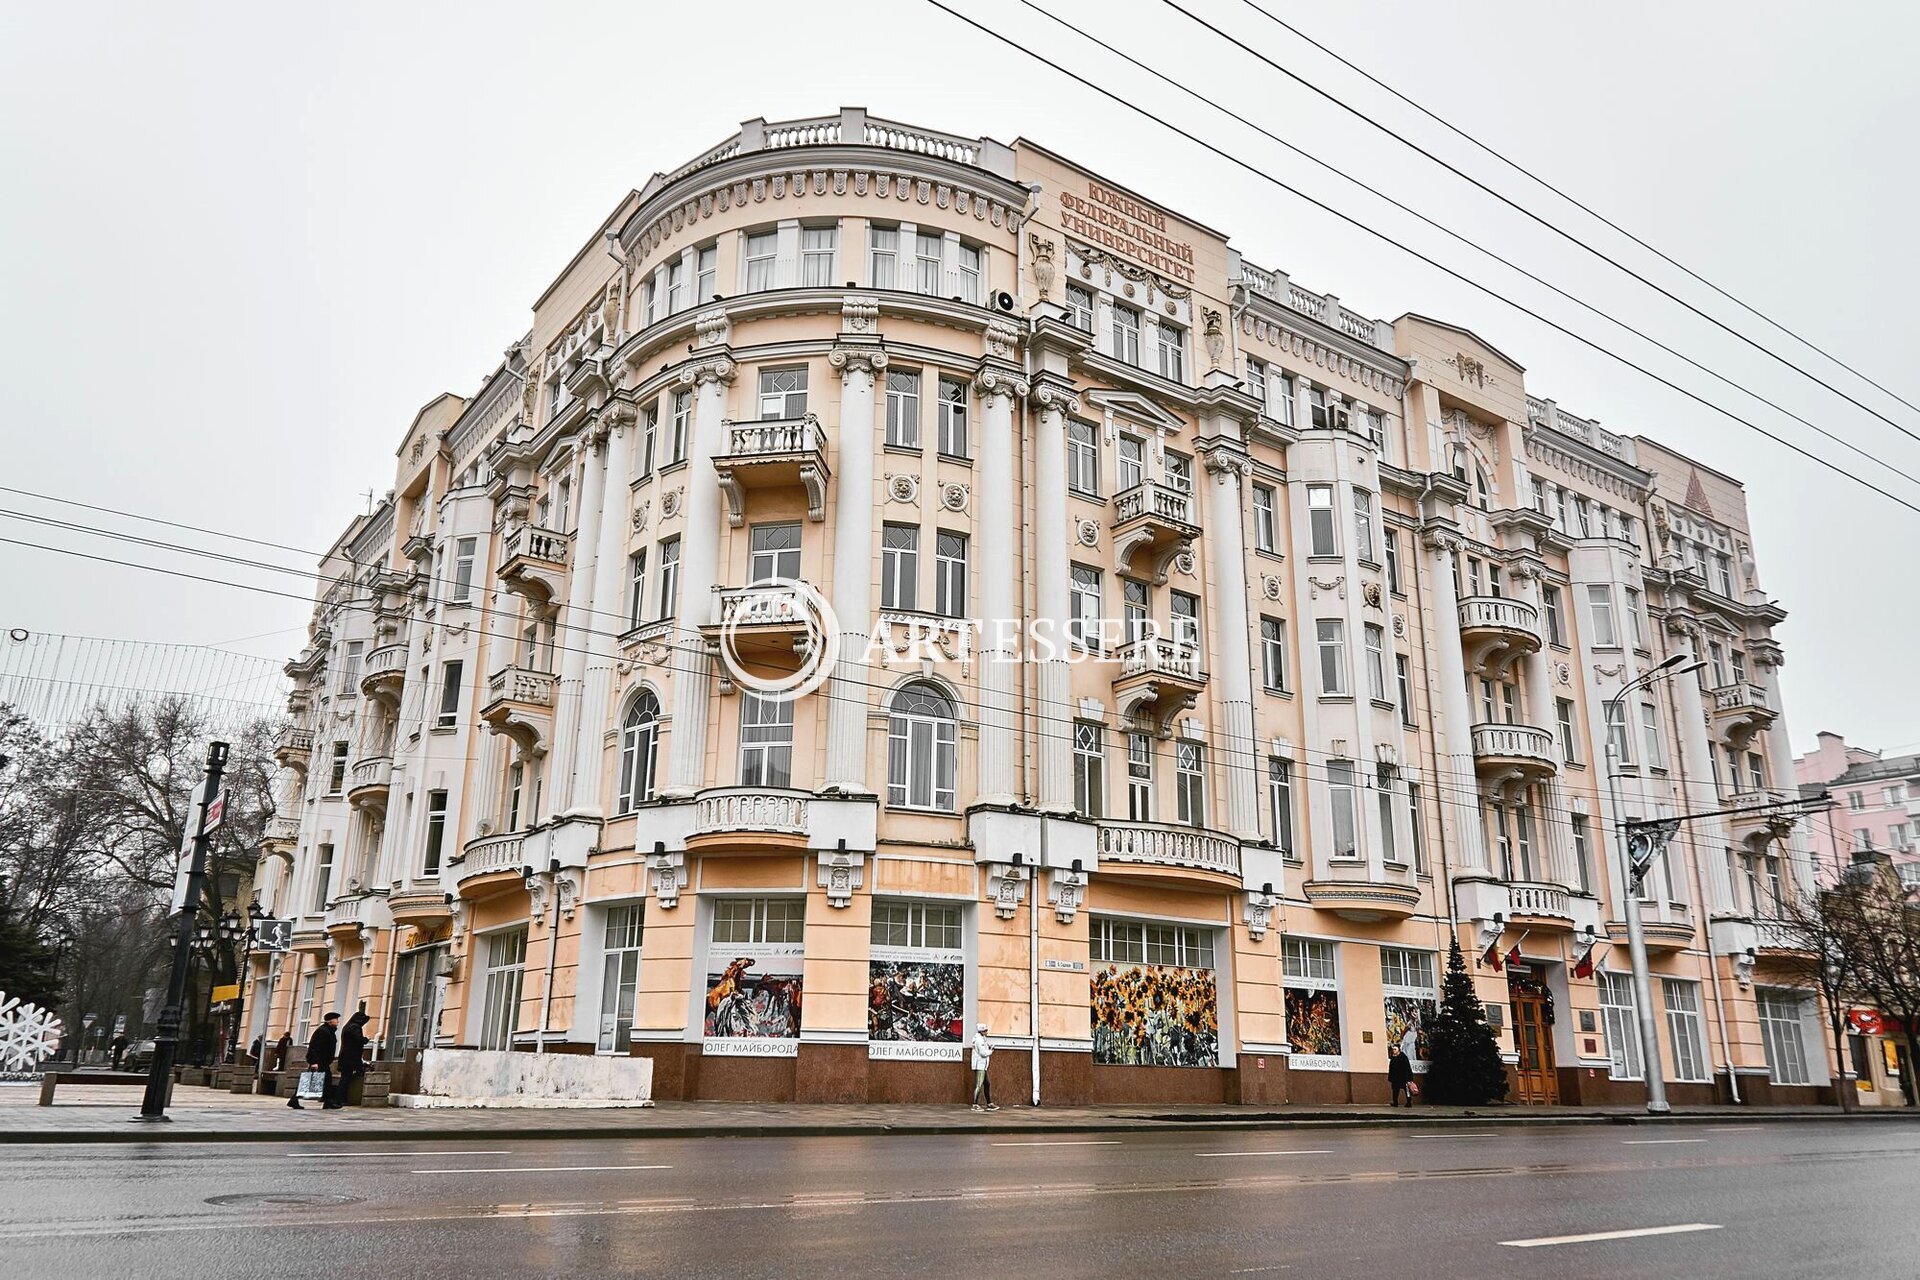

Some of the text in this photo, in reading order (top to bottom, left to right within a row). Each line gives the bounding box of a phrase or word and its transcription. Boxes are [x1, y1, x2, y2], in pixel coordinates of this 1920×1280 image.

[1088, 181, 1167, 233] ЮЖНЫЙ
[1060, 191, 1194, 265] ФЕДЕРАЛЬНЫЙ
[1060, 210, 1195, 284] УНИВЕРСИТЕТ
[704, 1042, 798, 1054] ОЛЕГ МАЙБОРОДА
[869, 1046, 961, 1059] ОЛЕГ МАЙБОРОДА
[1299, 1058, 1340, 1068] МАЙБОРОДА
